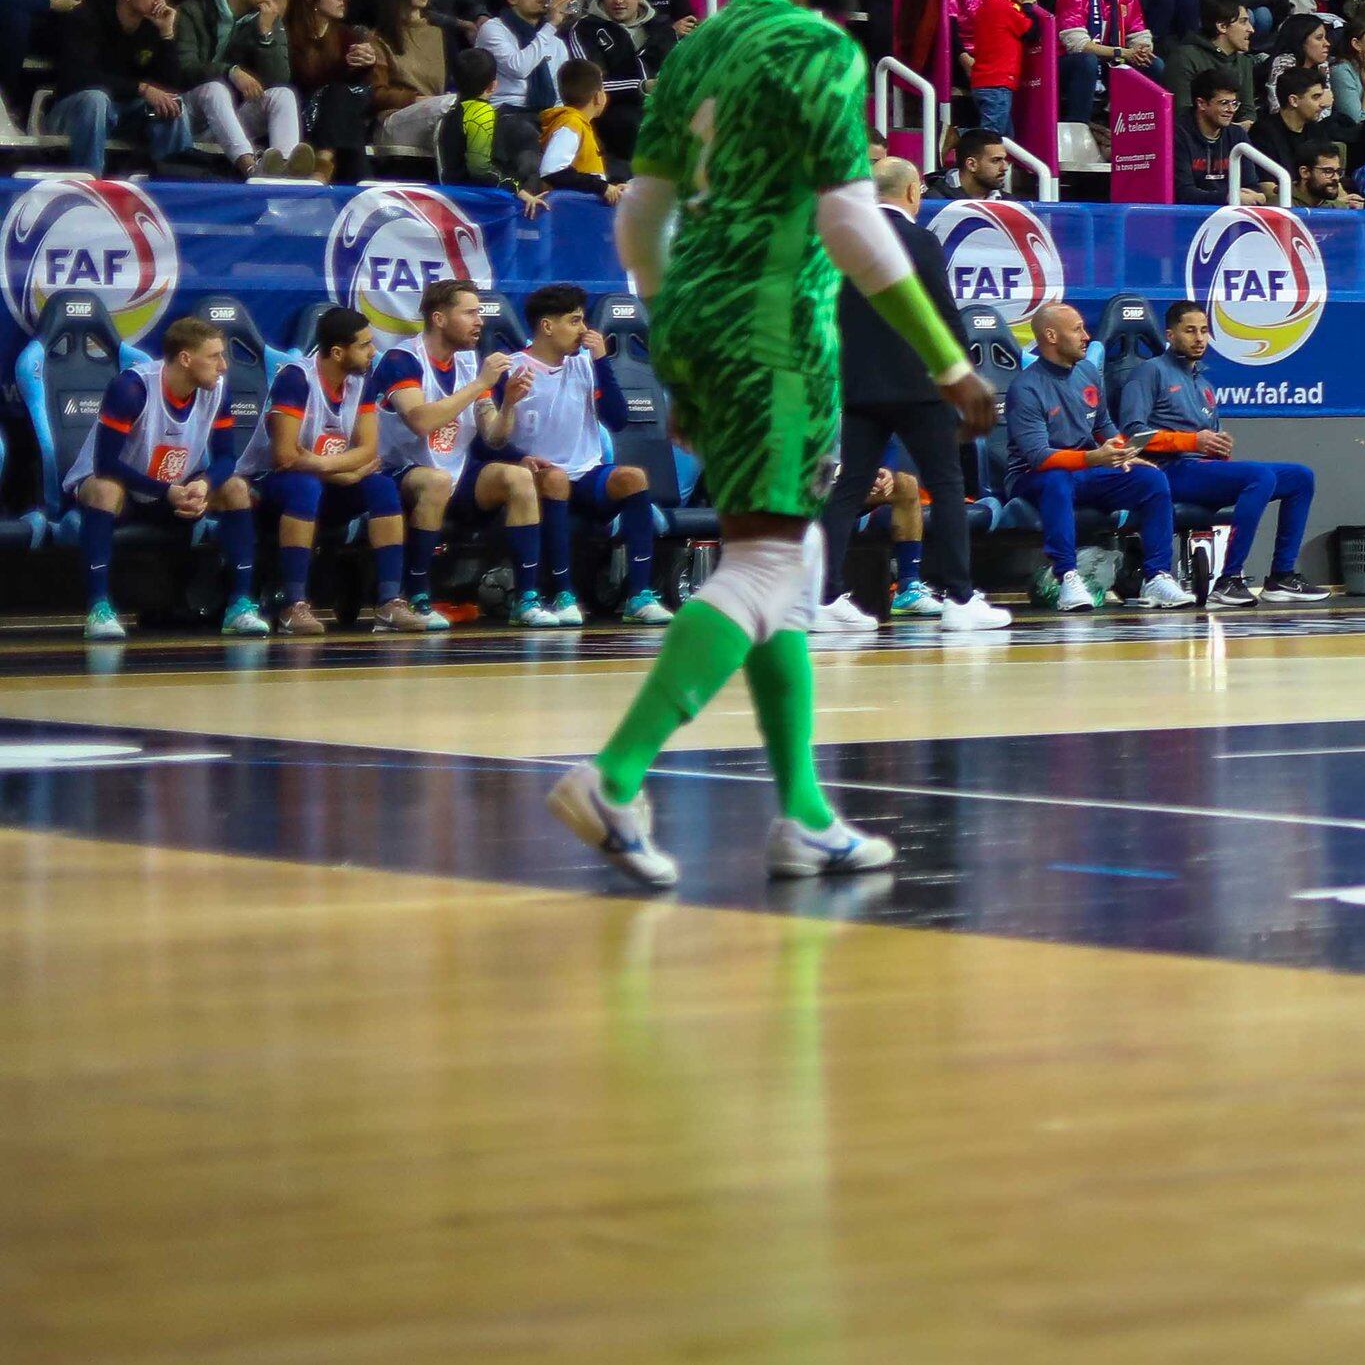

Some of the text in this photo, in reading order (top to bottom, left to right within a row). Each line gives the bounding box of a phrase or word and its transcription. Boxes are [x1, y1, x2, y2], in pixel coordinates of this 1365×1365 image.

[1128, 111, 1155, 122] andorra
[1128, 122, 1156, 133] telecom
[46, 248, 130, 285] FAF
[368, 256, 444, 291] FAF
[954, 266, 1024, 300] FAF
[1223, 269, 1289, 302] FAF
[66, 302, 92, 317] OMP
[209, 306, 236, 320] OMP
[612, 306, 636, 317] OMP
[1122, 306, 1144, 319] OMP
[973, 316, 997, 328] OMP
